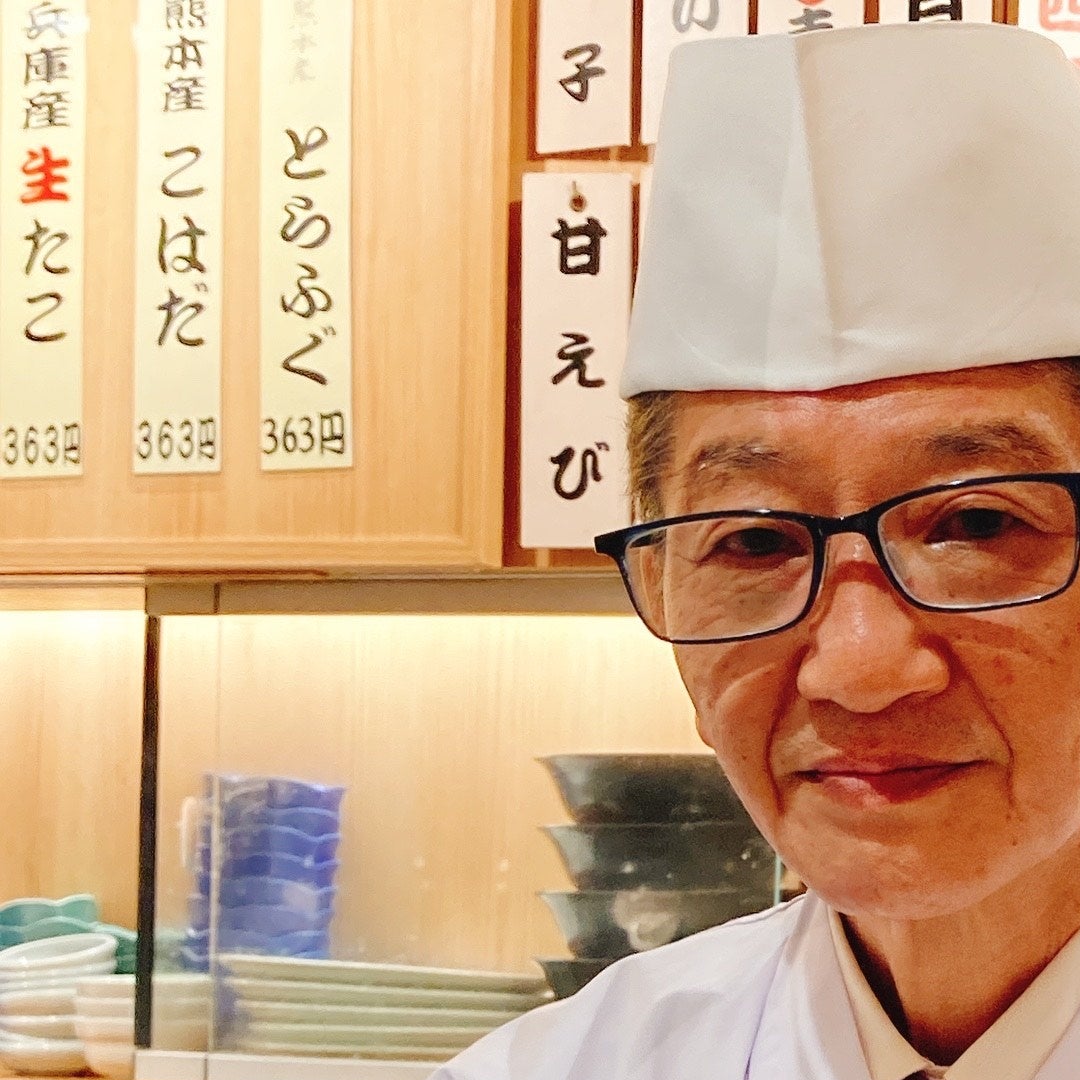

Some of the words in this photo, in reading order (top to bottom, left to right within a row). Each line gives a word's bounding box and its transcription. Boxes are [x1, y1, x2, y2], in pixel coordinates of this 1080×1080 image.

[559, 43, 606, 103] 子
[280, 125, 337, 386] とらふぐ
[549, 216, 610, 500] 甘えび
[3, 423, 82, 466] 363円
[137, 417, 217, 461] 363円
[262, 411, 346, 456] 363円
